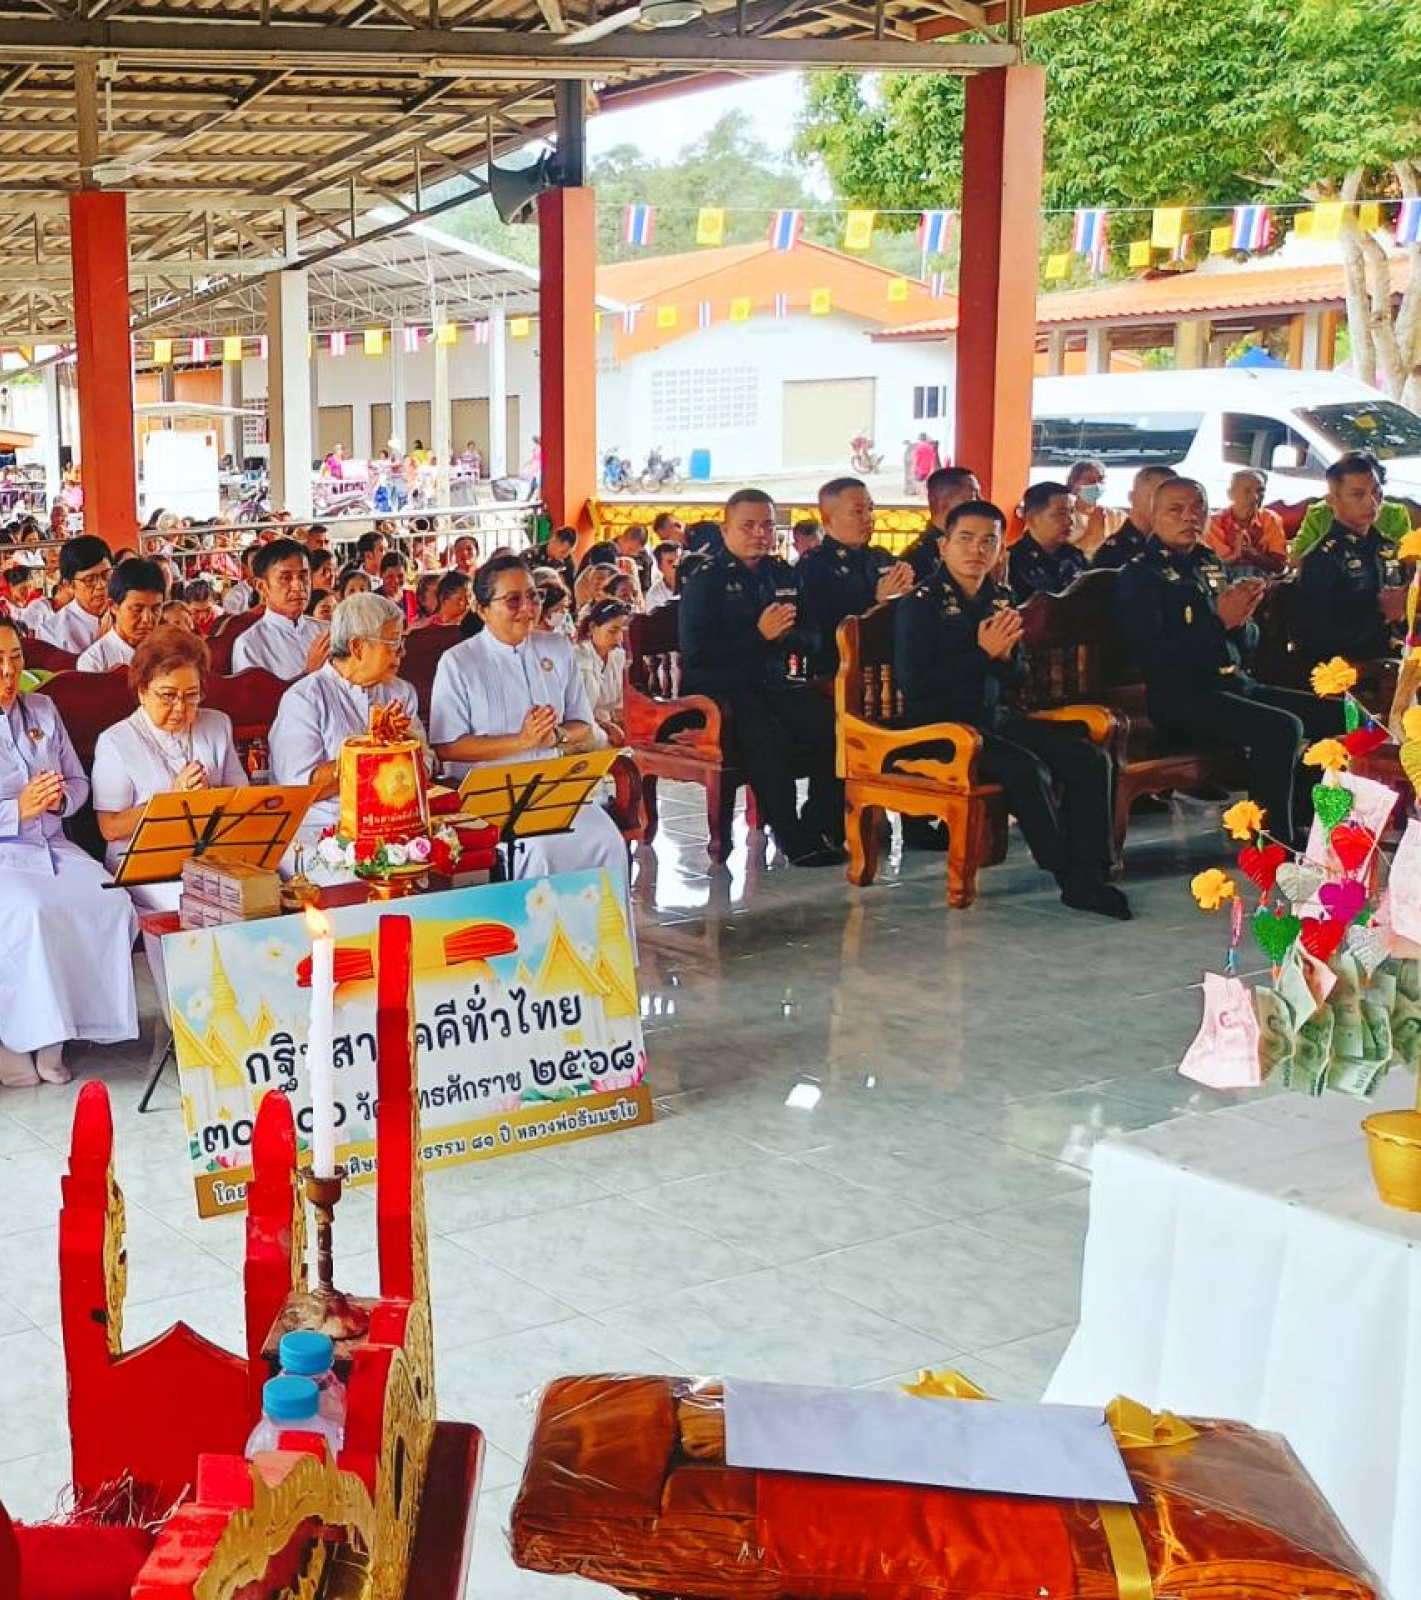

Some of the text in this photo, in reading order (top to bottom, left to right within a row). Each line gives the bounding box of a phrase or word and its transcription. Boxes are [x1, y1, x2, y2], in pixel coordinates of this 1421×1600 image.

[246, 984, 581, 1093] กฐิสาคคีทั่วไทย
[531, 1040, 636, 1086] ๒๕๖๘
[500, 1125, 511, 1144] ปี
